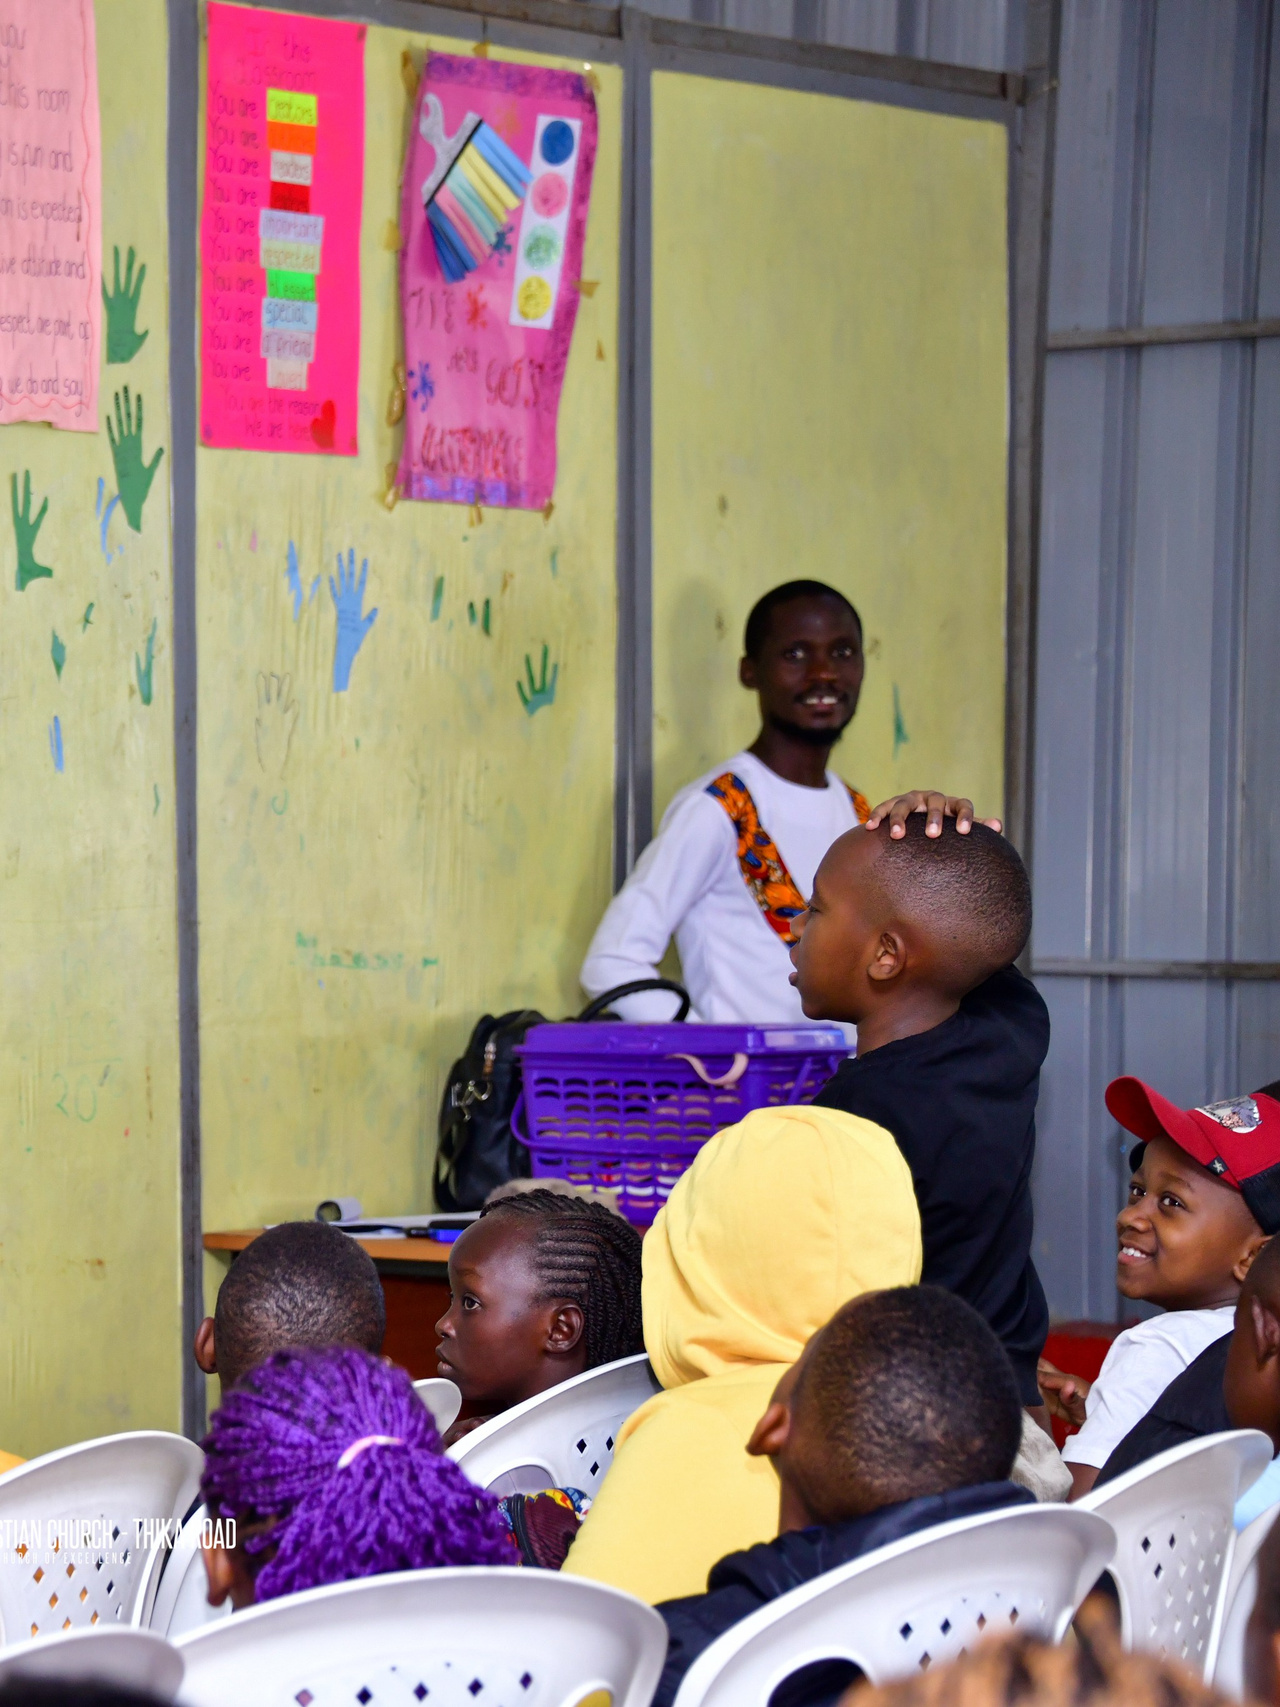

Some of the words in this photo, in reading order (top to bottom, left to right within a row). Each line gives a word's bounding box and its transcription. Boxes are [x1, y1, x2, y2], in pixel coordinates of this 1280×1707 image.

[36, 87, 70, 115] room
[49, 130, 75, 173] and
[64, 250, 86, 281] and
[40, 359, 61, 396] and
